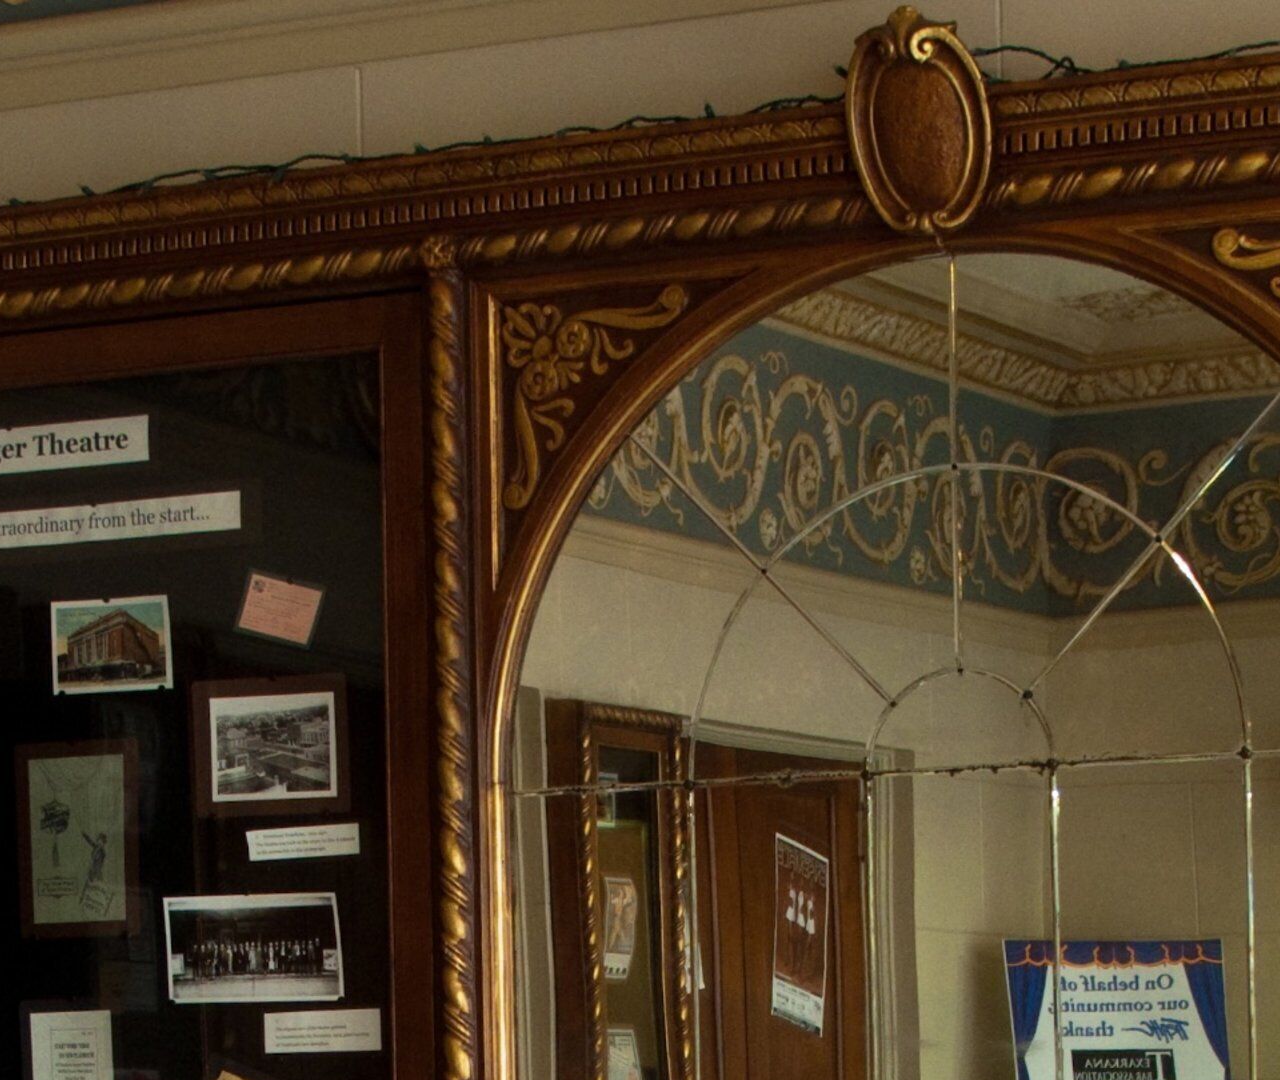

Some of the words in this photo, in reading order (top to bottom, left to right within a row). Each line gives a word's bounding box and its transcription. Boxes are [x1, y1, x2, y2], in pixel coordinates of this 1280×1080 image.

[33, 430, 129, 457] Theatre
[87, 511, 127, 532] from
[130, 508, 156, 528] the
[158, 503, 211, 525] start...
